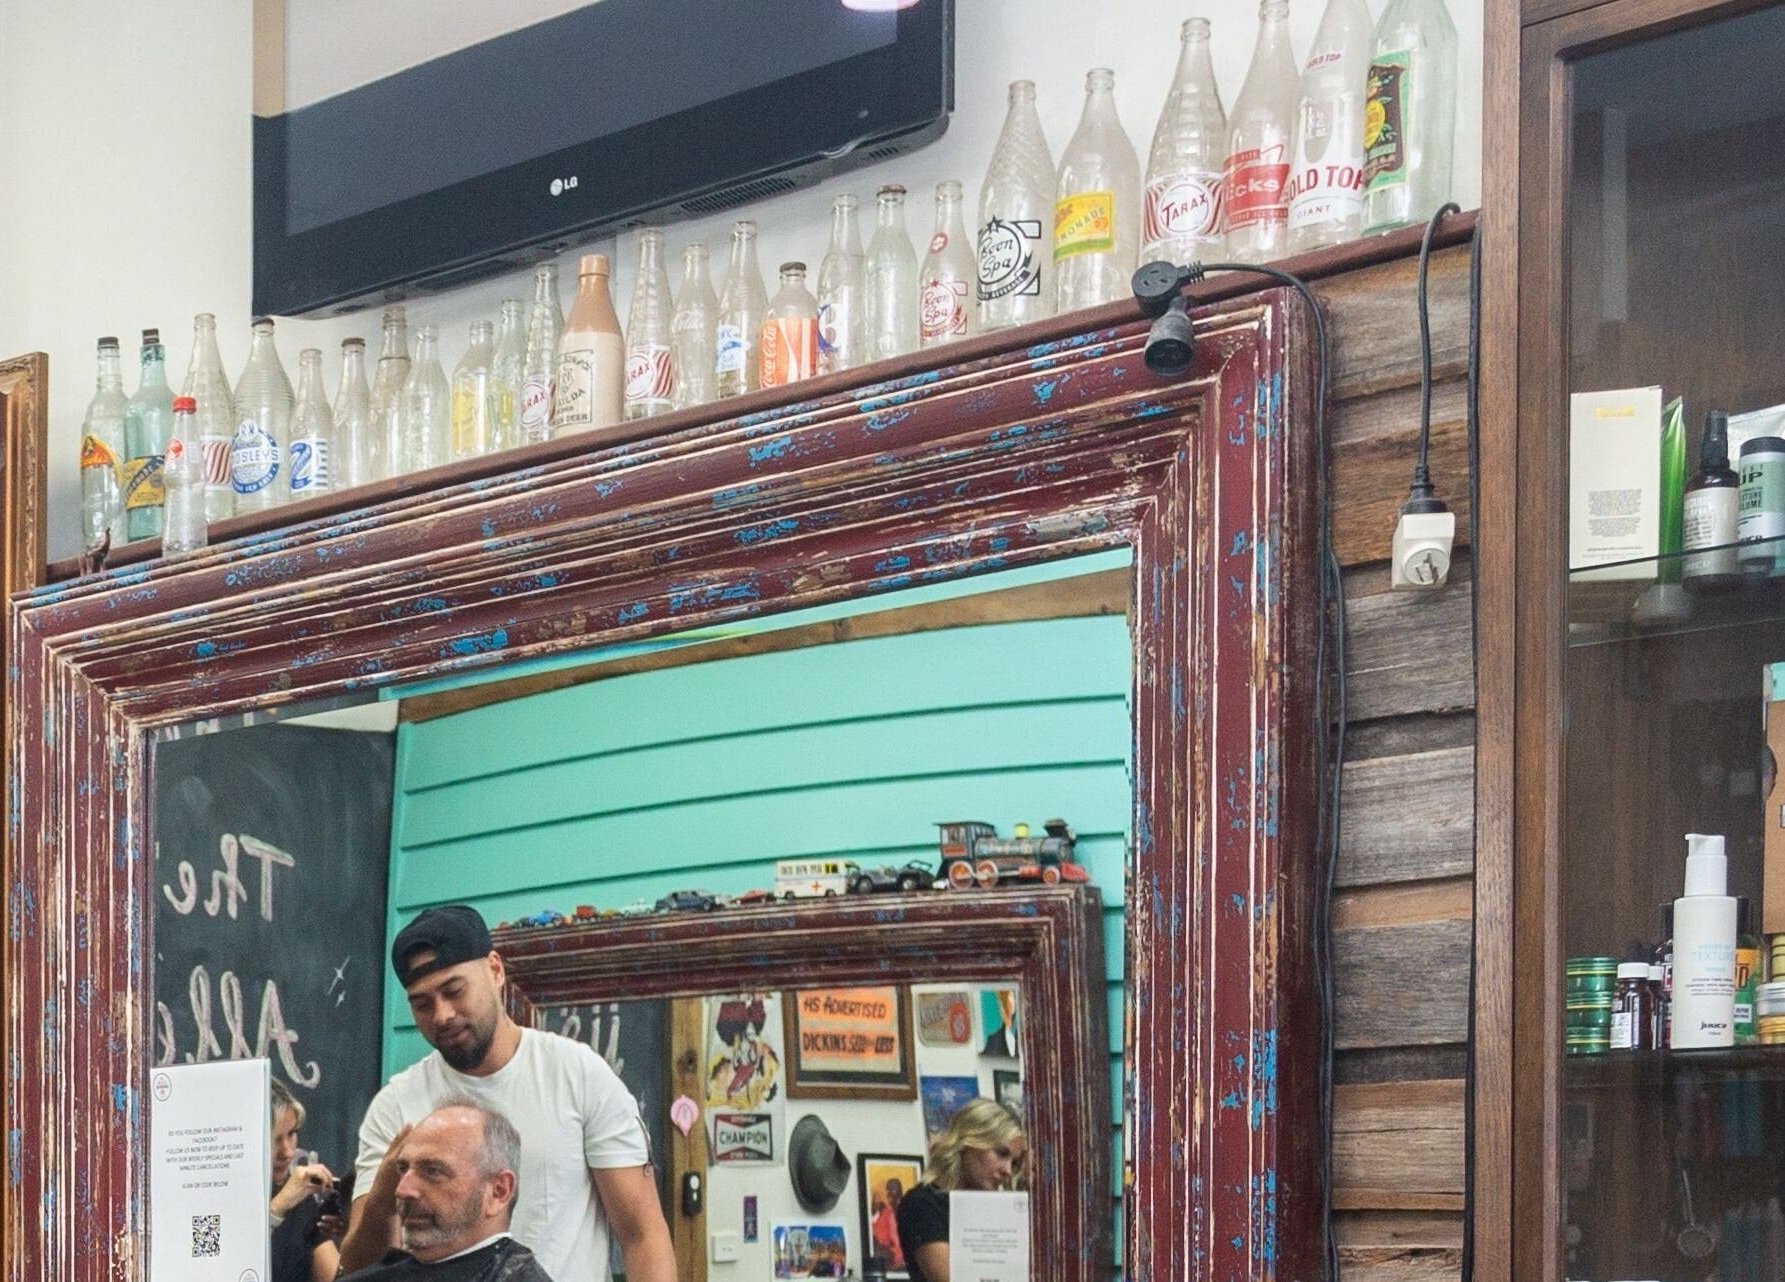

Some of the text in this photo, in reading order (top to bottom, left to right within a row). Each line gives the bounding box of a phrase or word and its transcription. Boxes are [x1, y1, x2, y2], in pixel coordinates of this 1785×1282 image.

[563, 175, 579, 192] LG
[1161, 192, 1209, 227] TARAX
[982, 256, 1012, 279] Spa
[824, 996, 887, 1020] ADVERTISED
[803, 1032, 847, 1052] DICKINS
[719, 1131, 769, 1146] CHAMPION
